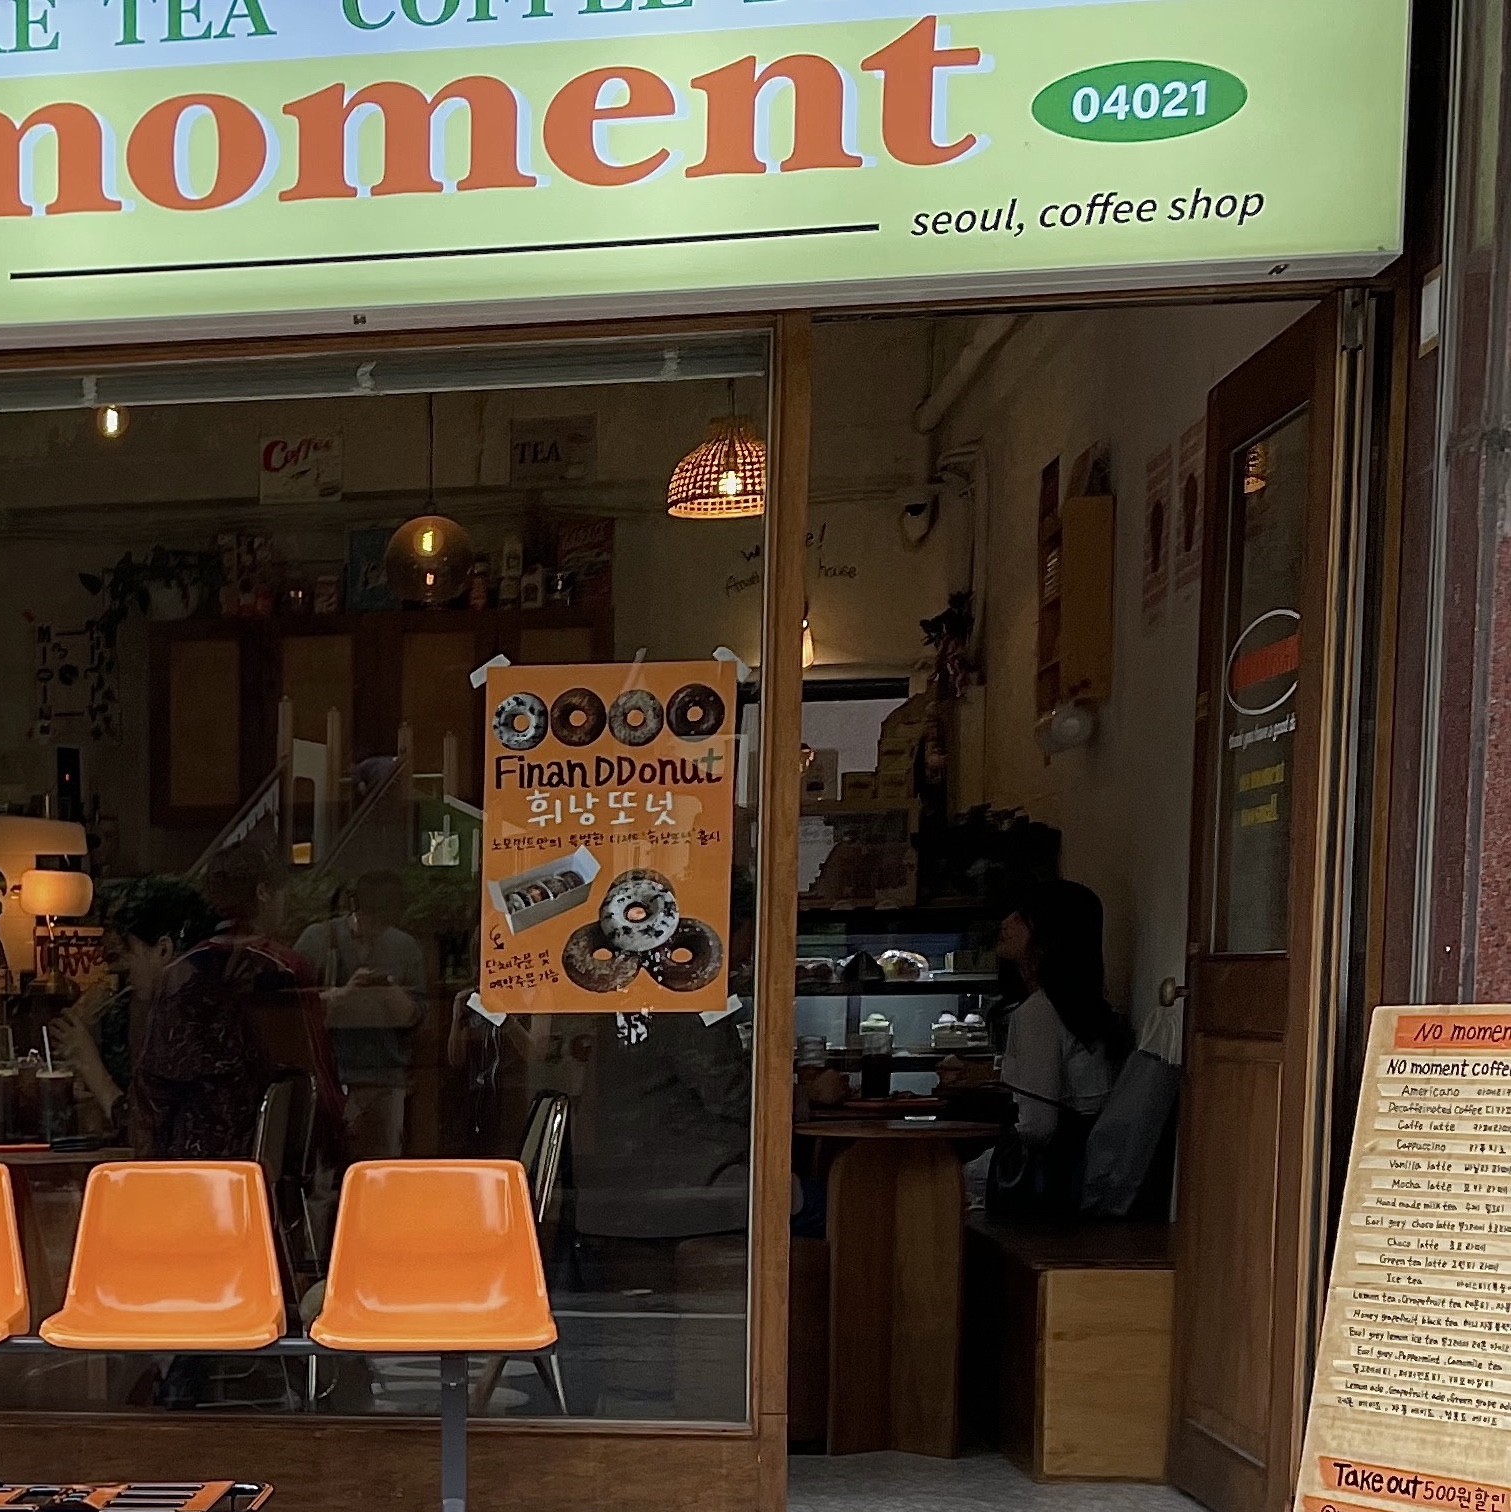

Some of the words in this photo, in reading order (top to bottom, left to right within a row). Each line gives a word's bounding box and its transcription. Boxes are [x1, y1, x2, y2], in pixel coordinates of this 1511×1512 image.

[1070, 79, 1209, 123] 04021
[909, 196, 1025, 239] seoul,
[1037, 189, 1159, 230] coffee
[1167, 187, 1266, 231] shop
[1387, 1059, 1407, 1075] NO
[1410, 1059, 1469, 1077] moment
[1401, 1085, 1460, 1097] Americano
[1333, 1462, 1384, 1493] Take
[1386, 1475, 1424, 1499] out
